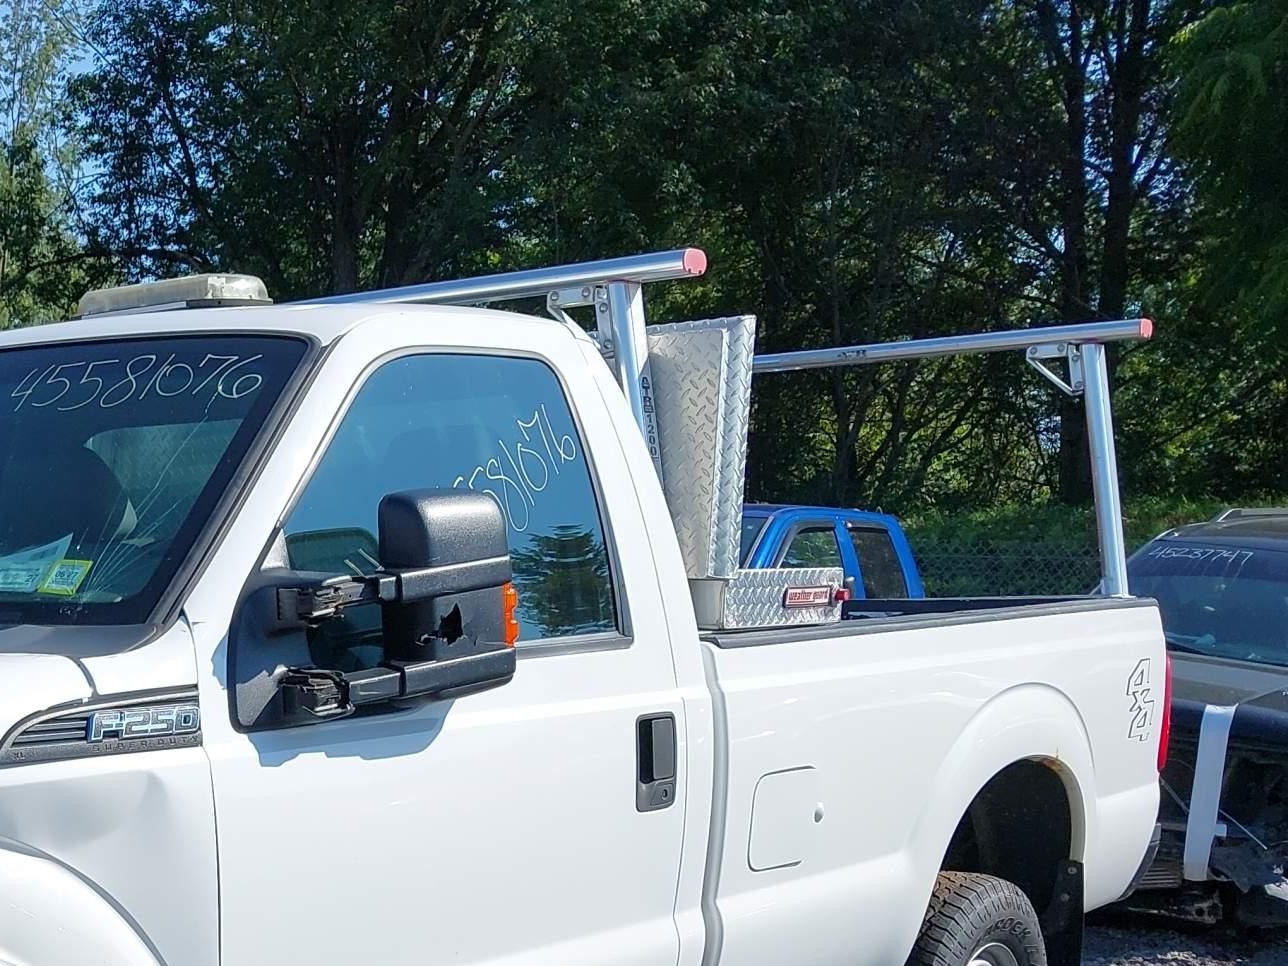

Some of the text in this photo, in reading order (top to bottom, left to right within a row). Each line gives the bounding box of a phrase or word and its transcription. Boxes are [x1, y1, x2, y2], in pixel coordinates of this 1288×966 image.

[11, 353, 263, 412] 45581076
[1148, 546, 1254, 567] 45237747
[88, 706, 201, 743] F-250
